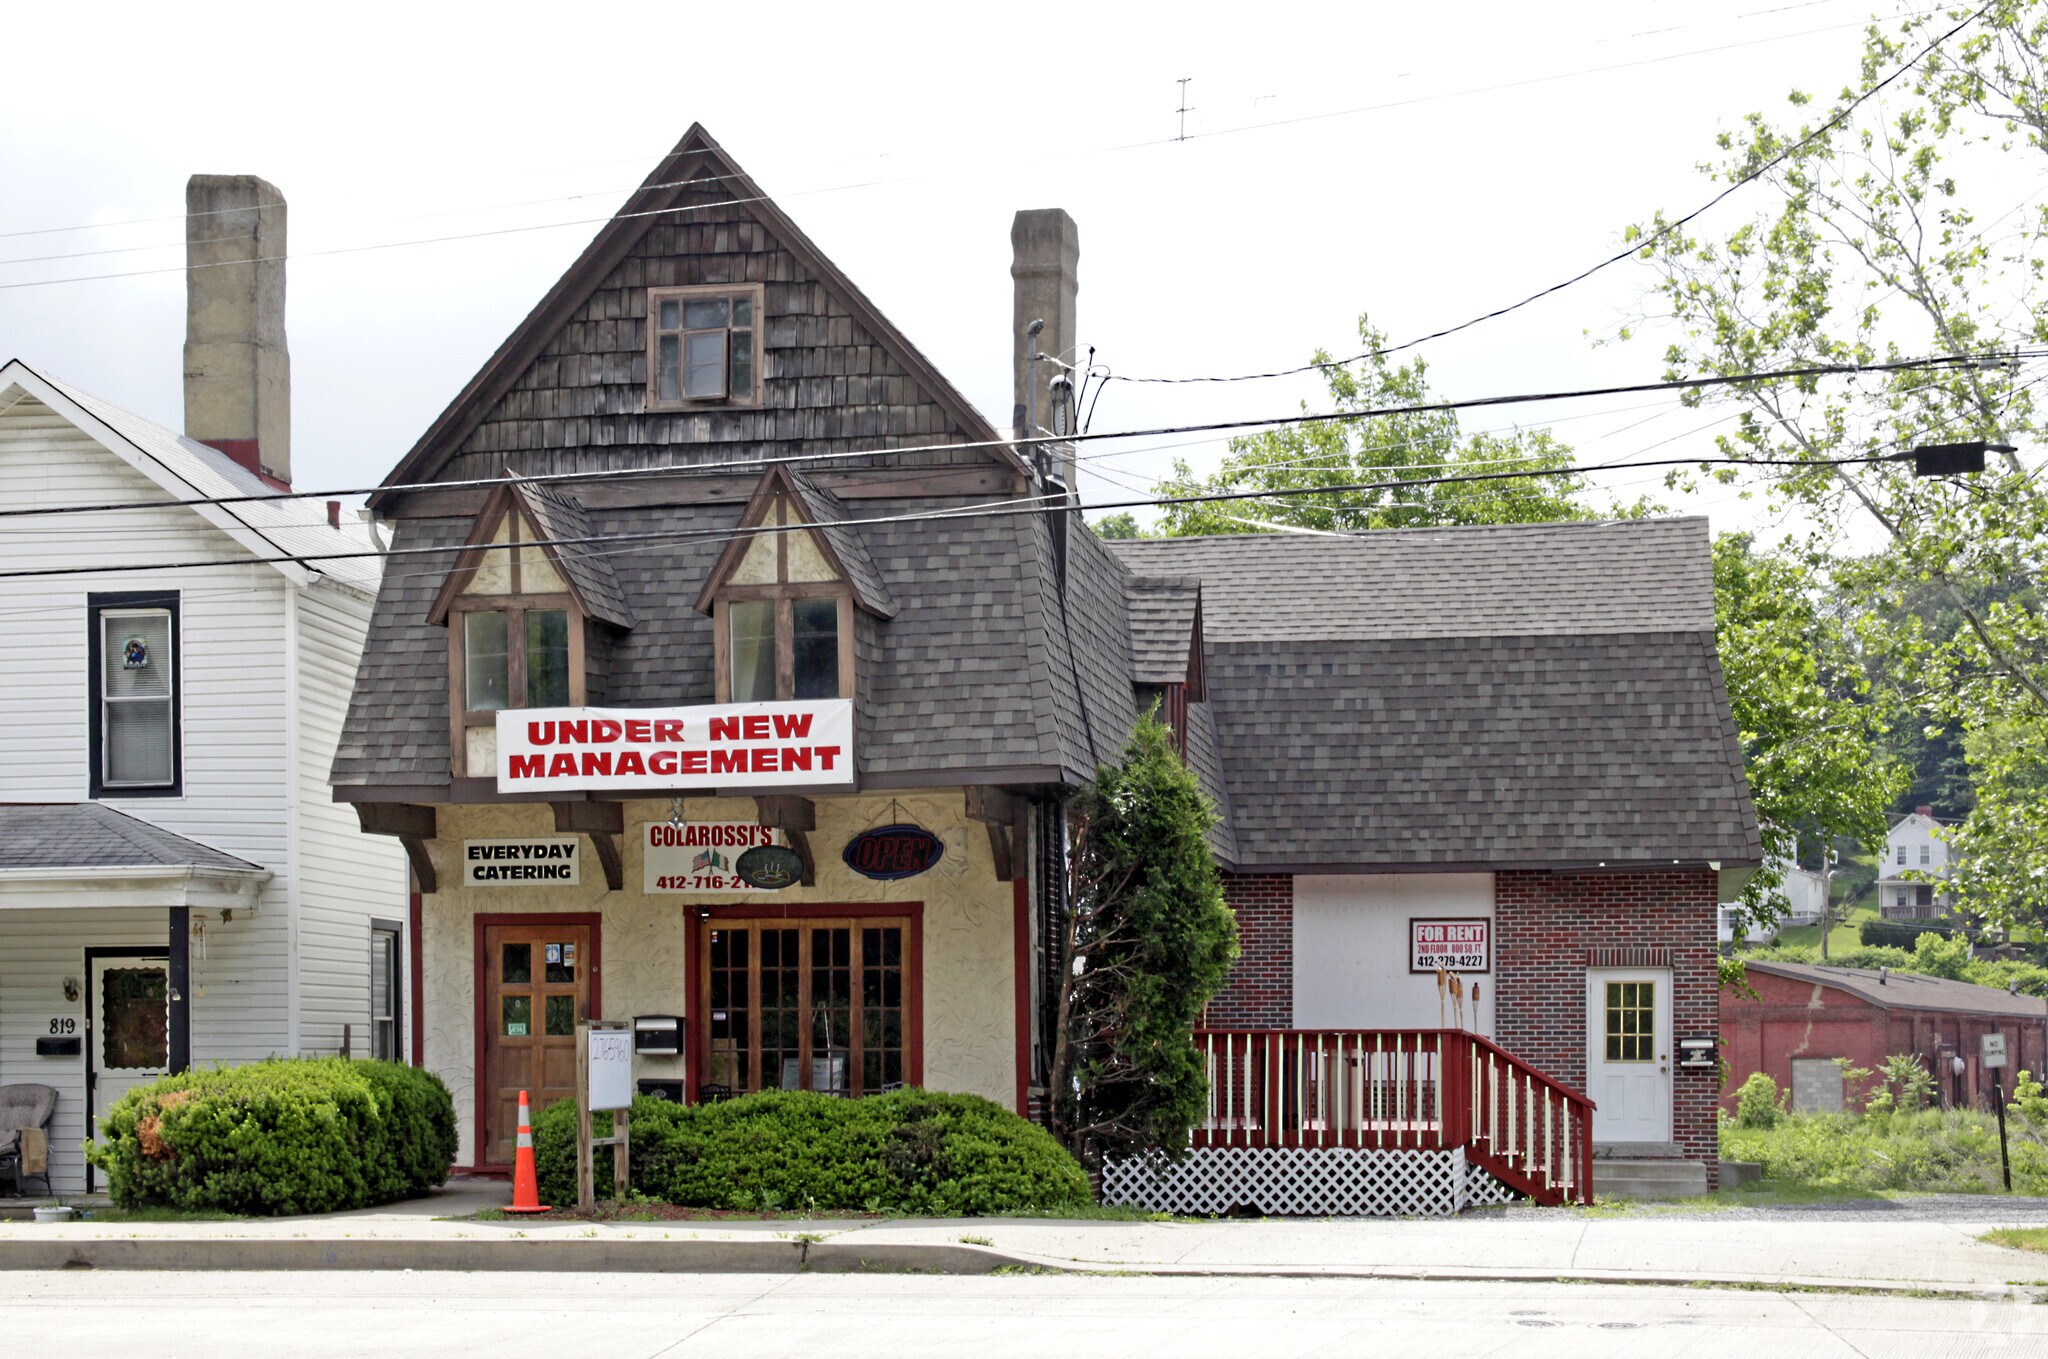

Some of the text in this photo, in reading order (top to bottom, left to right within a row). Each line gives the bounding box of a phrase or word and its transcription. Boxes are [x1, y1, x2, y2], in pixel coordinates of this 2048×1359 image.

[527, 713, 814, 746] UNDER NEW
[508, 745, 841, 779] MANAGEMENT
[650, 825, 772, 847] COLAROSSI'S
[468, 844, 576, 860] EVERYDAY
[855, 837, 932, 871] OPEN
[473, 864, 571, 880] CATERING
[1418, 926, 1482, 941] FOR RENT
[1417, 944, 1429, 954] 2ND
[1430, 944, 1448, 954] FLOOR
[1451, 944, 1463, 954] 800
[49, 1018, 75, 1034] 819
